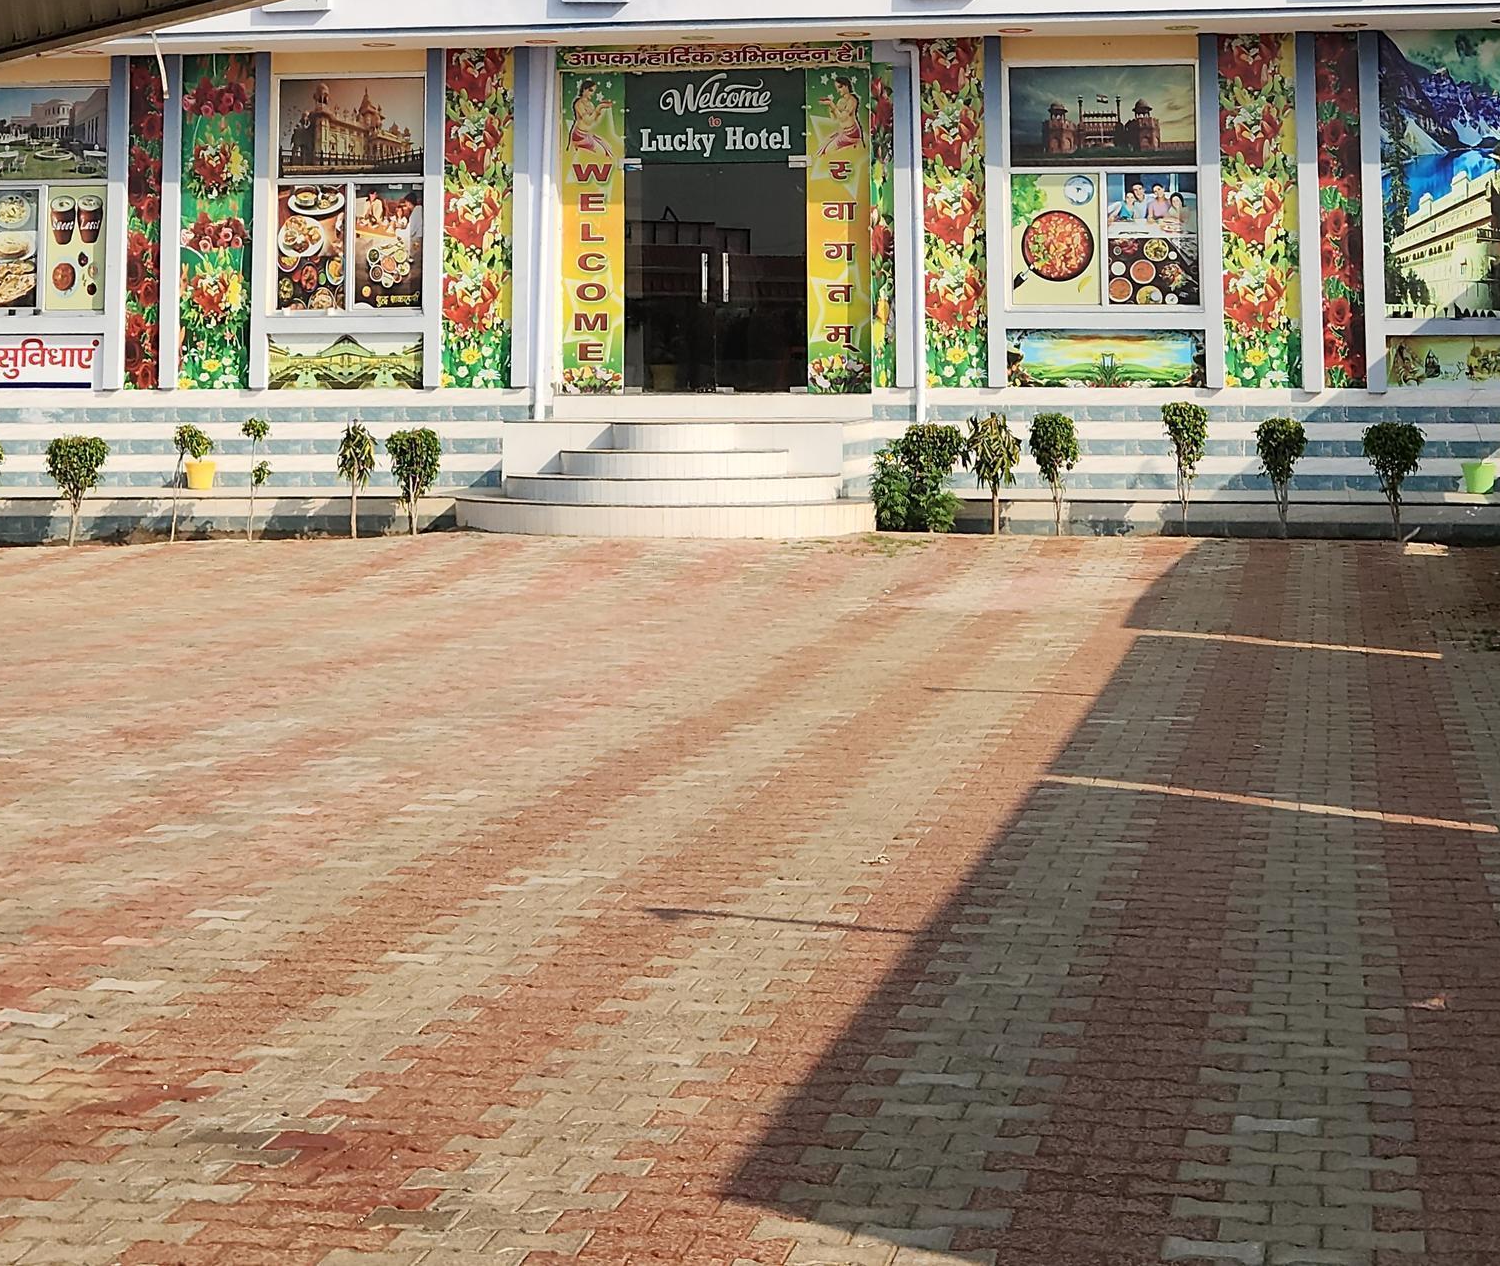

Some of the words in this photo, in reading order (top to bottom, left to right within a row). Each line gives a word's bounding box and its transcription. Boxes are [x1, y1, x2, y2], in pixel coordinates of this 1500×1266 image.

[568, 50, 642, 67] आपका
[660, 73, 772, 115] Welcome
[708, 116, 721, 127] to
[640, 127, 715, 157] Lucky
[725, 126, 792, 150] Hotel
[572, 162, 613, 364] WELCOME
